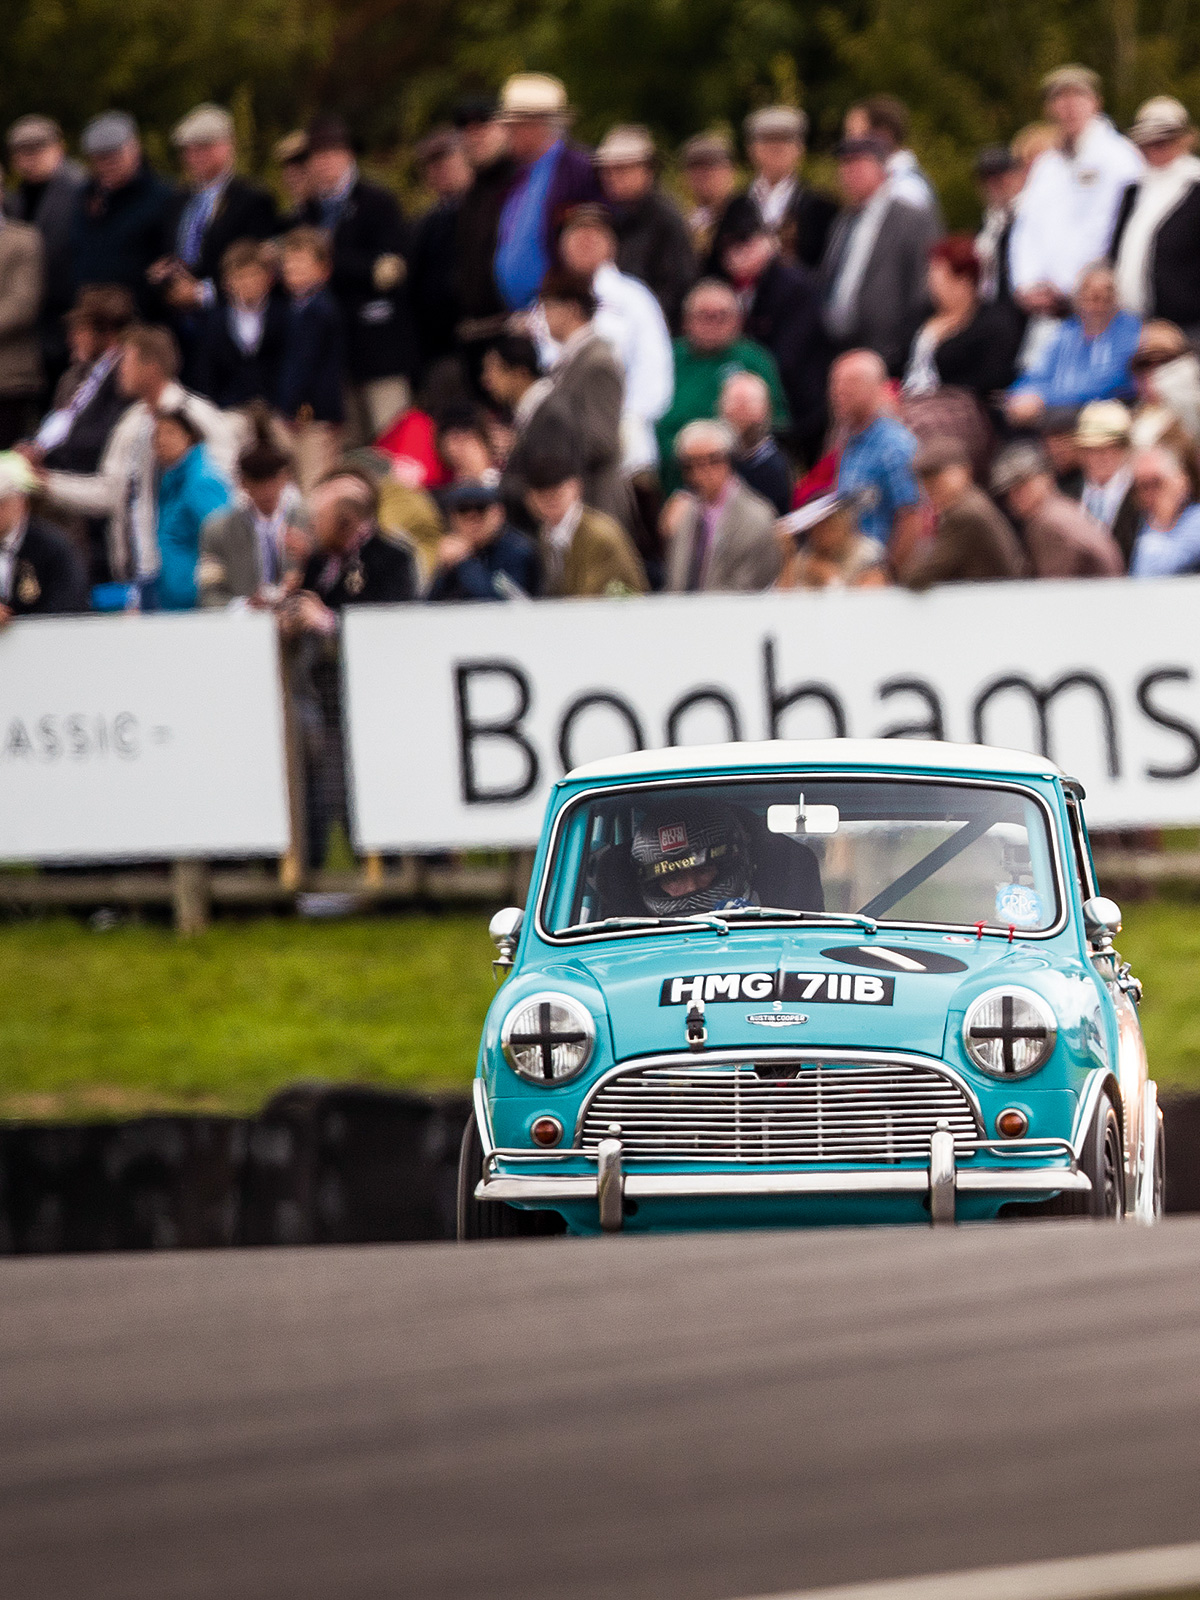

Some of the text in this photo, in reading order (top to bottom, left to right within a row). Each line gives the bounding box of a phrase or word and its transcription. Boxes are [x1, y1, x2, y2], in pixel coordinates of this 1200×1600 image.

[654, 856, 696, 875] #Fever
[670, 973, 885, 1003] HMG 711B
[772, 1000, 783, 1011] S
[776, 1014, 806, 1022] COOPER
